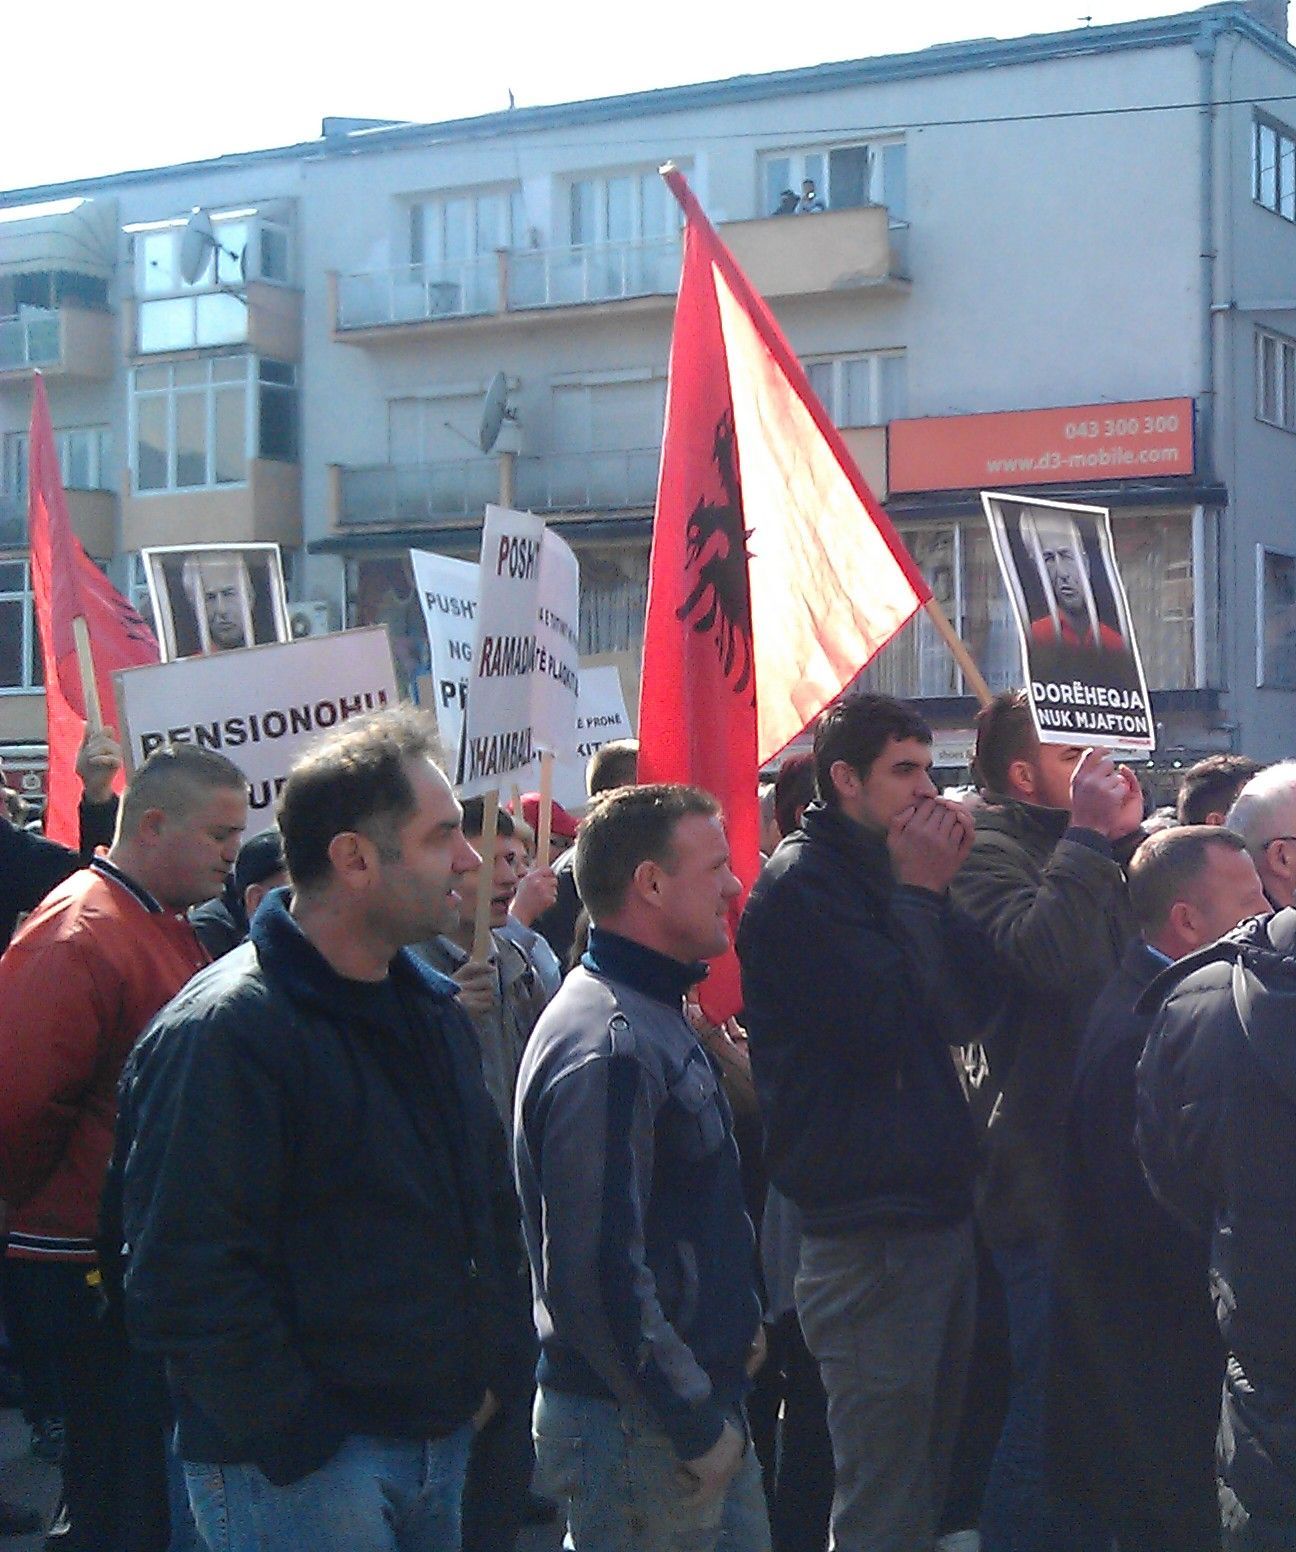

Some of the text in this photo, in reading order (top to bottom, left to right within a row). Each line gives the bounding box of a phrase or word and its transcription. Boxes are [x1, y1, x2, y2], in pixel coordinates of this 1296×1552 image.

[1064, 415, 1179, 439] 043 300 300
[986, 446, 1178, 473] www.d3-mobile.com
[1032, 681, 1145, 710] DORËHEQJA
[1038, 708, 1148, 733] NUK MJAFTON
